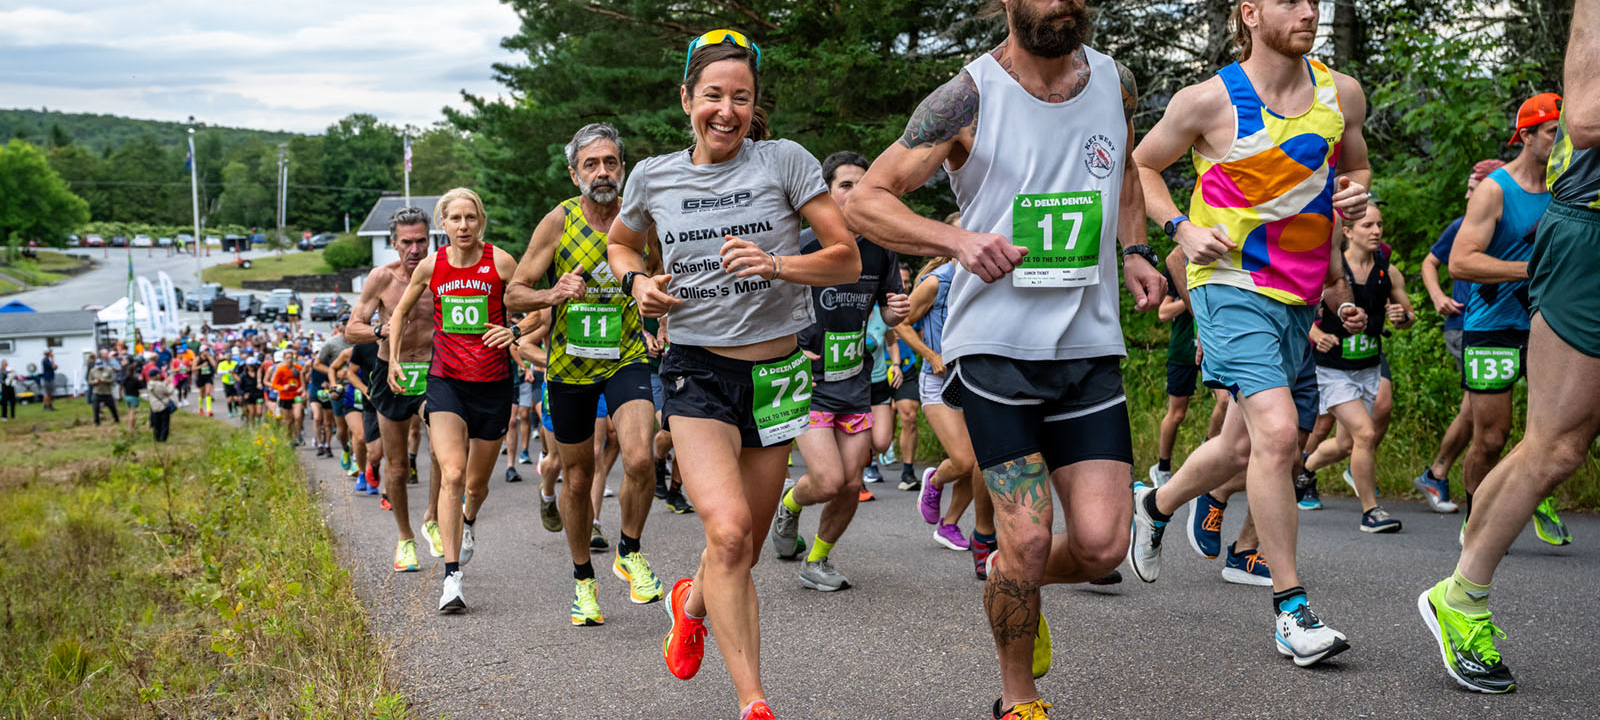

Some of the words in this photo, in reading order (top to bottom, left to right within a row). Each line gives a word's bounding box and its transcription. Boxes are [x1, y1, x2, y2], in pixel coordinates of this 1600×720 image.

[1084, 134, 1097, 150] KEY
[1098, 134, 1116, 151] WEST
[1034, 198, 1060, 207] DELTA
[1062, 196, 1093, 206] DENTAL
[679, 228, 718, 242] DELTA
[721, 221, 773, 237] DENTAL
[1037, 211, 1083, 251] 17
[477, 266, 490, 274] NB
[672, 258, 730, 275] Charlie'
[437, 279, 493, 296] WHIRLAWAY
[679, 285, 730, 299] Ollies's
[734, 280, 772, 295] Mom
[451, 305, 479, 326] 60
[581, 315, 607, 338] 11
[830, 337, 864, 363] 140
[1348, 334, 1377, 352] 152
[770, 364, 793, 374] DELTA
[792, 354, 808, 368] DENTA
[1469, 358, 1515, 380] 133
[408, 371, 419, 388] 7
[771, 370, 811, 408] 72
[759, 415, 771, 424] RACE
[780, 410, 790, 418] THE
